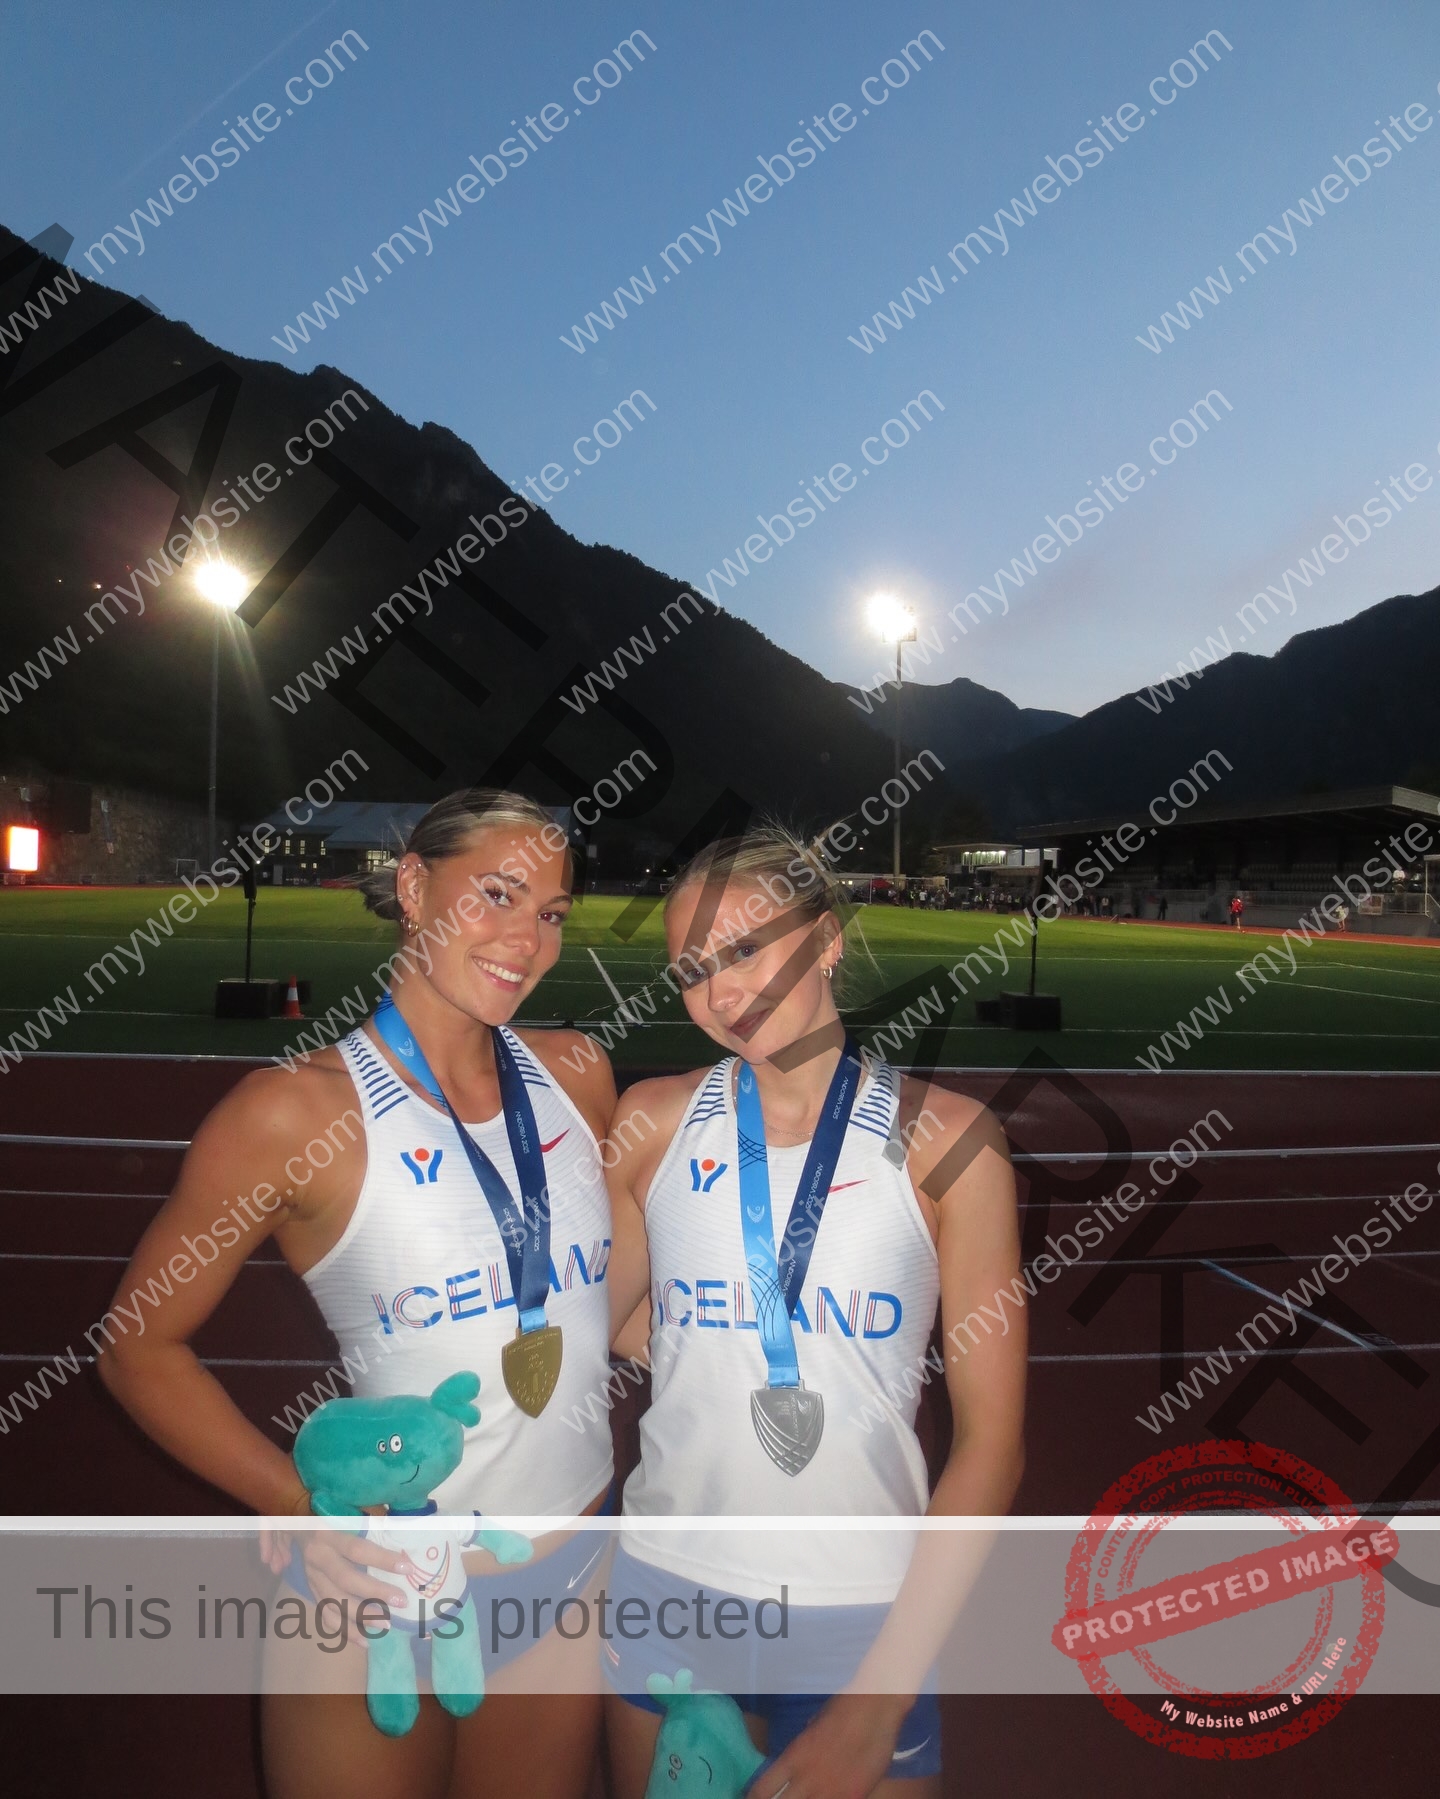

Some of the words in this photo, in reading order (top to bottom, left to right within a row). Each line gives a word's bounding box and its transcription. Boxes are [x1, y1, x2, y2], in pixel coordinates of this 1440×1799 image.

[837, 1076, 849, 1105] ANDORRA
[832, 1105, 841, 1120] 2025
[514, 1110, 527, 1140] ANDORRA
[521, 1140, 530, 1154] 2025
[810, 1162, 824, 1193] ANDORRA
